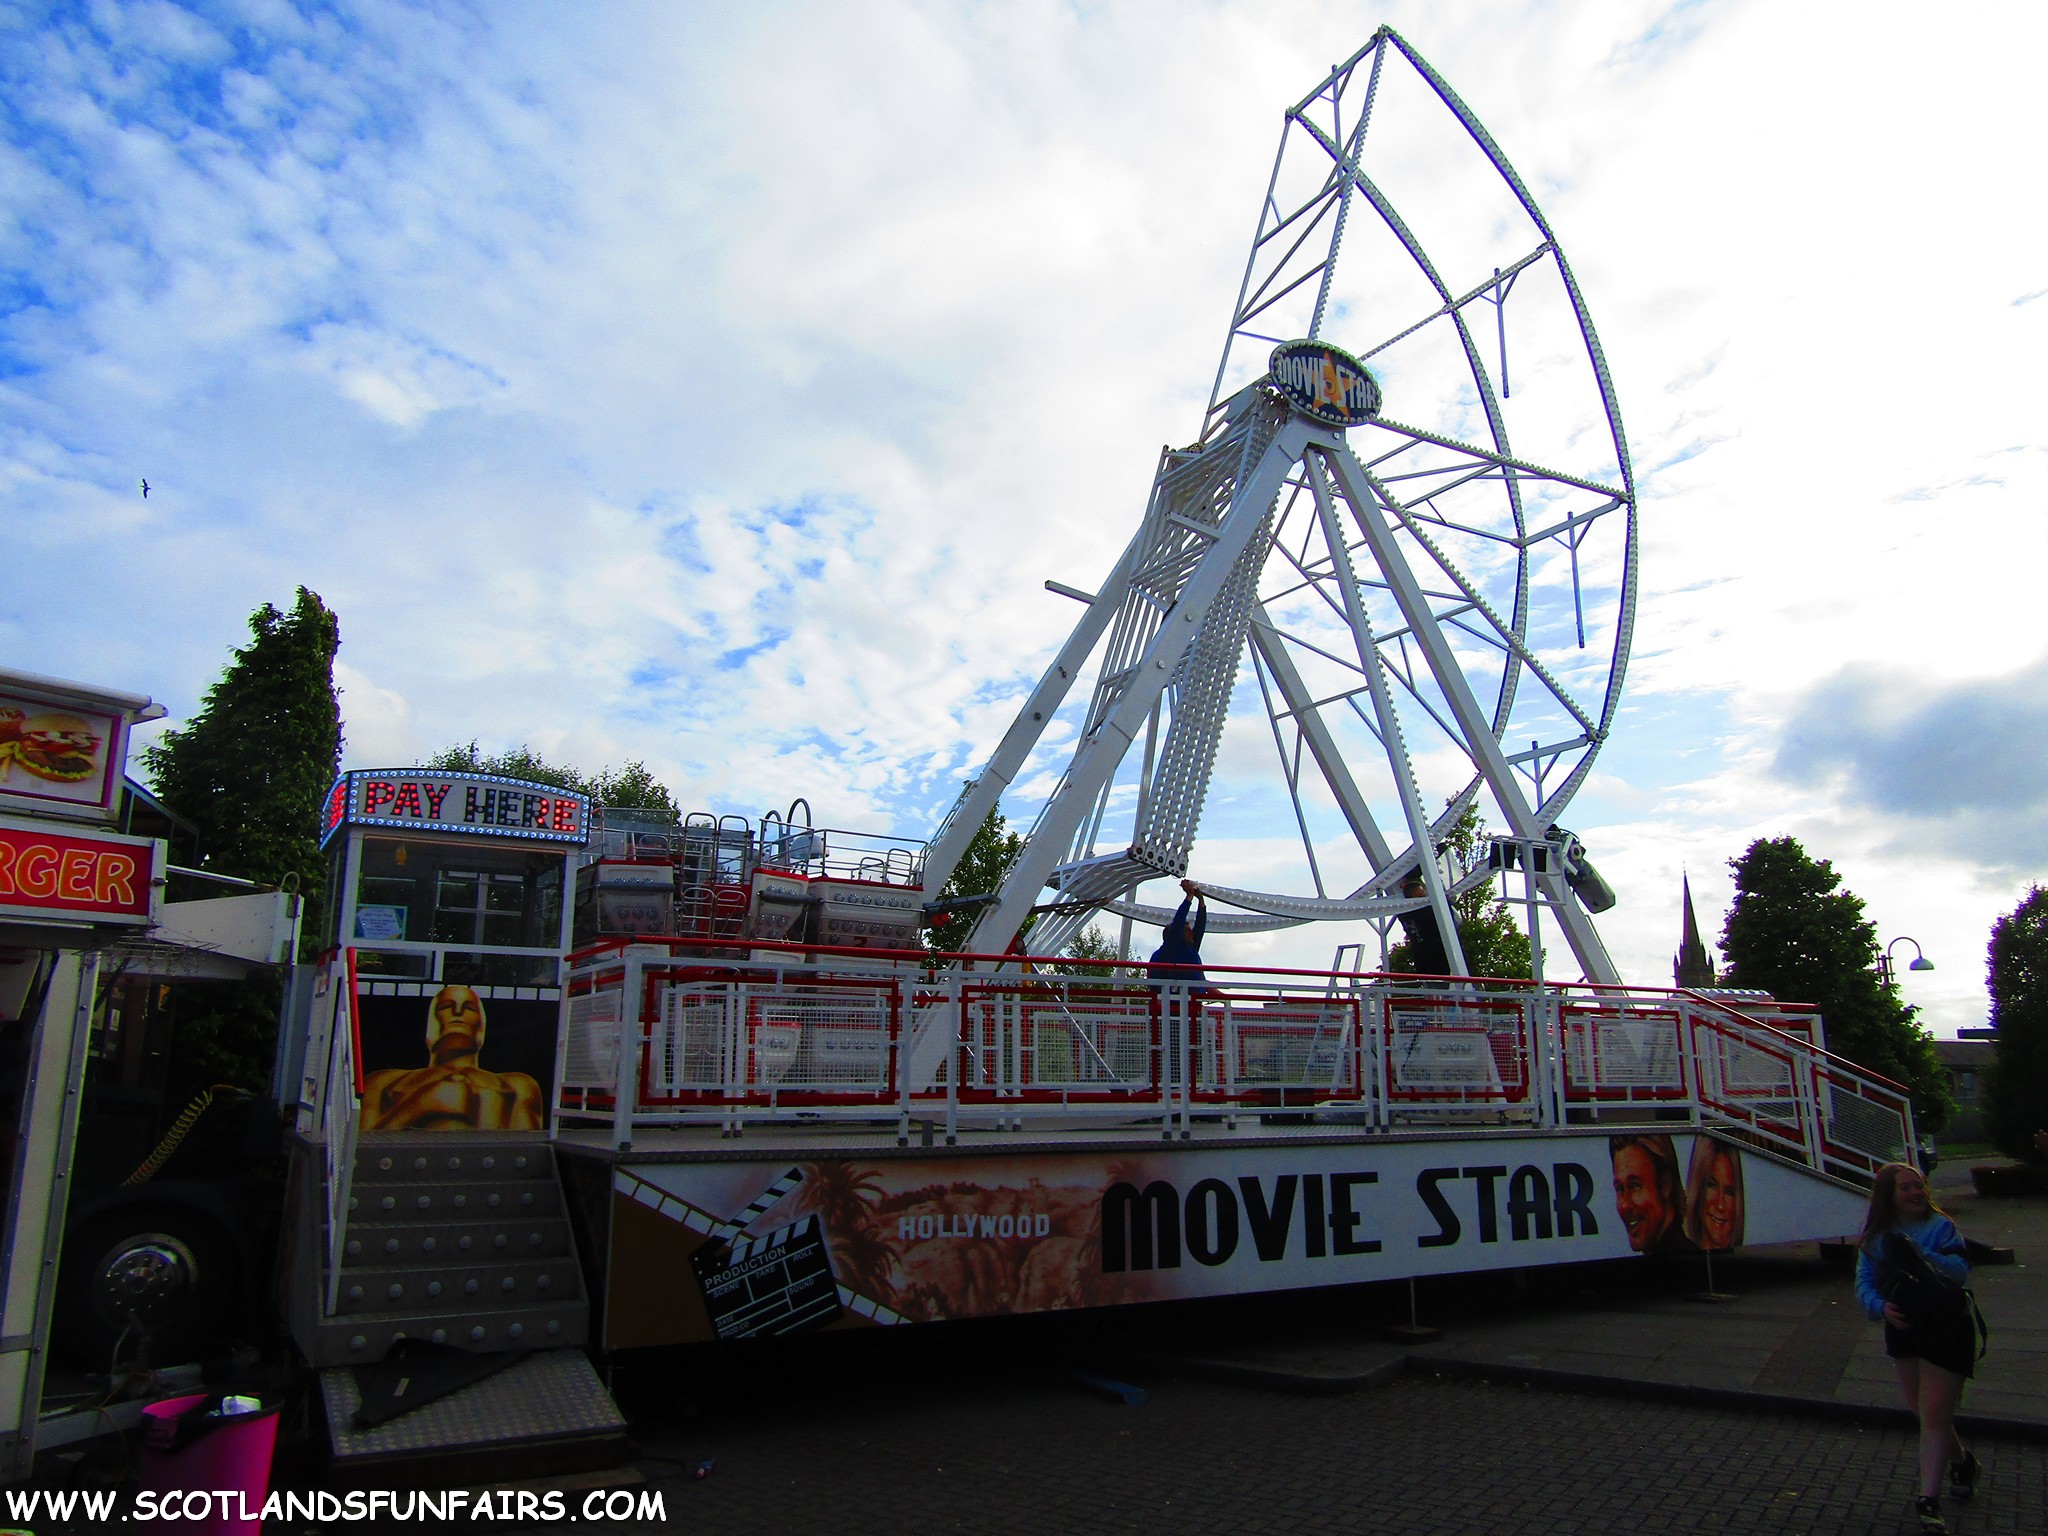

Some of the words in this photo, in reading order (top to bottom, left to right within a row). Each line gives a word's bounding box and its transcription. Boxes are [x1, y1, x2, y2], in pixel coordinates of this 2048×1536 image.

[1279, 356, 1331, 405] MOVIE
[1336, 364, 1377, 409] STAR
[364, 782, 452, 818] PAY
[464, 786, 577, 832] HERE
[900, 1213, 1050, 1239] HOLLYWOOD
[1102, 1172, 1381, 1273] MOVIE
[1417, 1162, 1599, 1248] STAR
[704, 1245, 787, 1289] PRODUCTION
[793, 1247, 815, 1263] ROLL
[755, 1264, 777, 1279] TAKE
[712, 1280, 742, 1298] SCENE
[789, 1278, 815, 1295] SOUND
